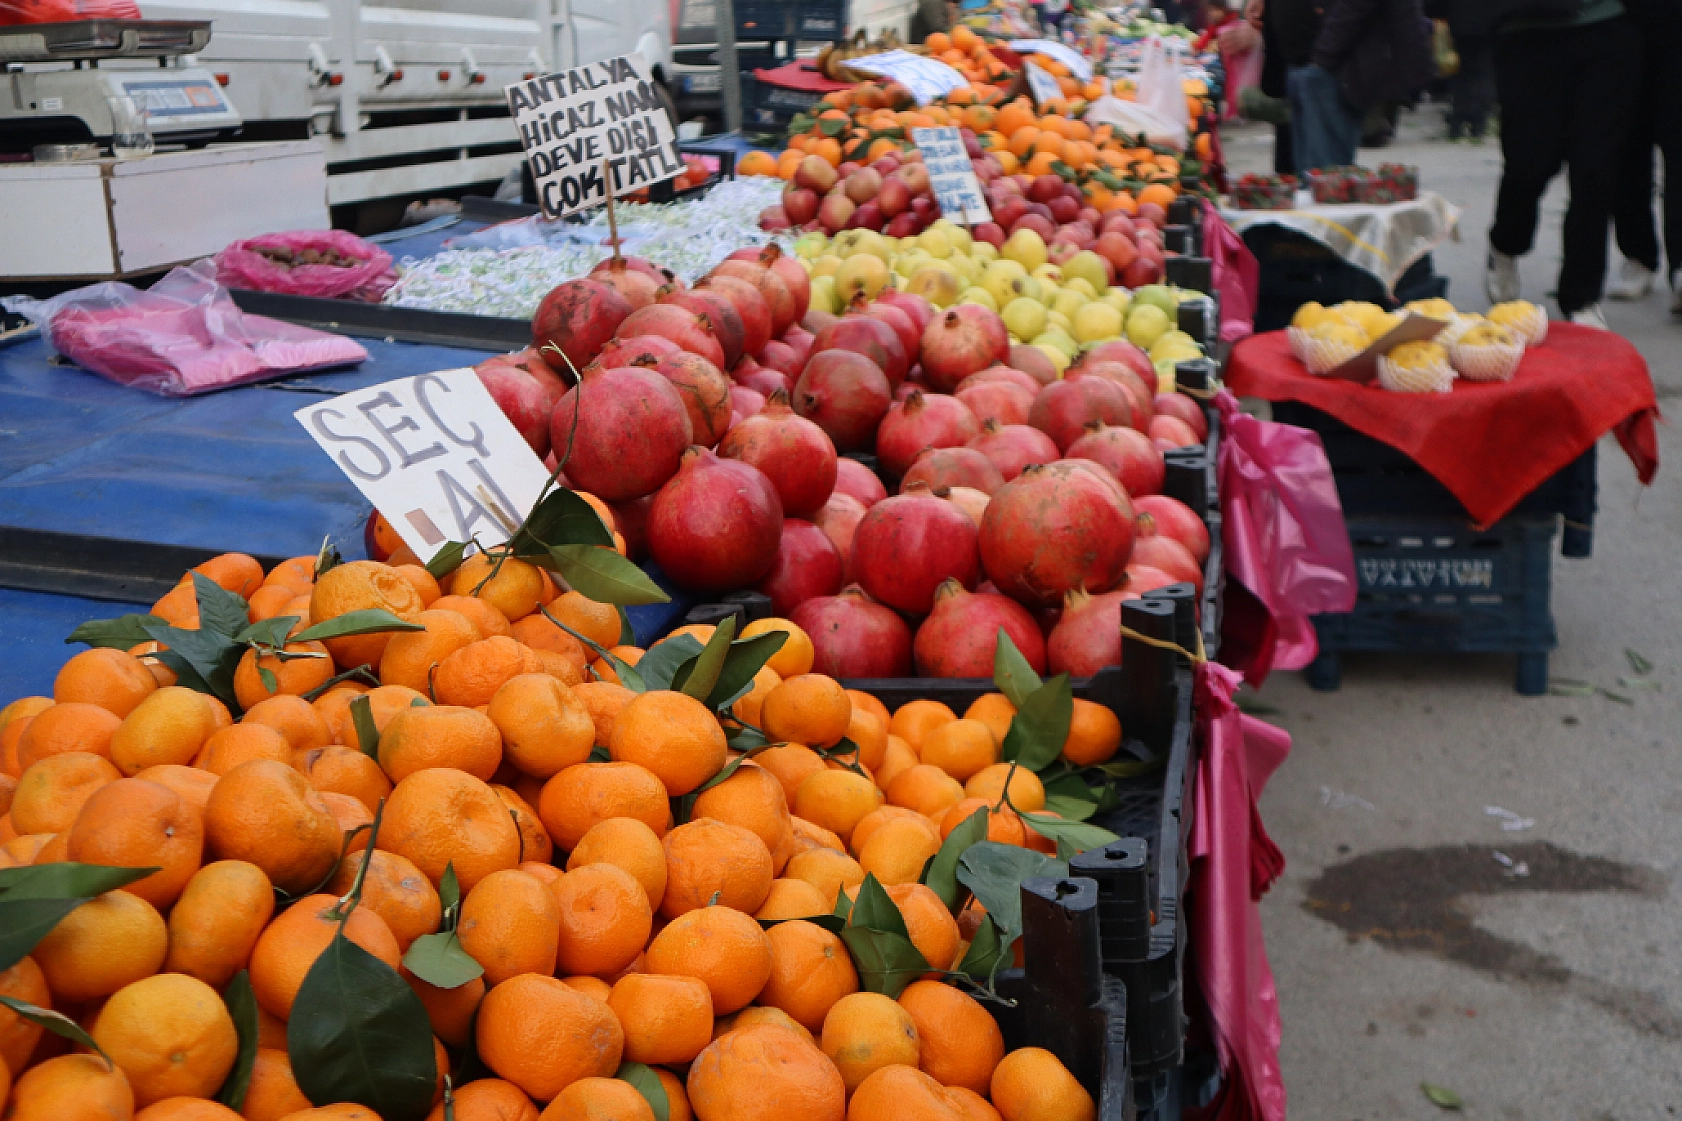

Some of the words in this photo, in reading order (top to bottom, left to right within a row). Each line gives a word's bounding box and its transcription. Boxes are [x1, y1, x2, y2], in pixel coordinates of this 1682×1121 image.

[508, 56, 640, 117] ANTALYA
[531, 135, 603, 179] DEVE
[310, 374, 491, 483] SEÇ
